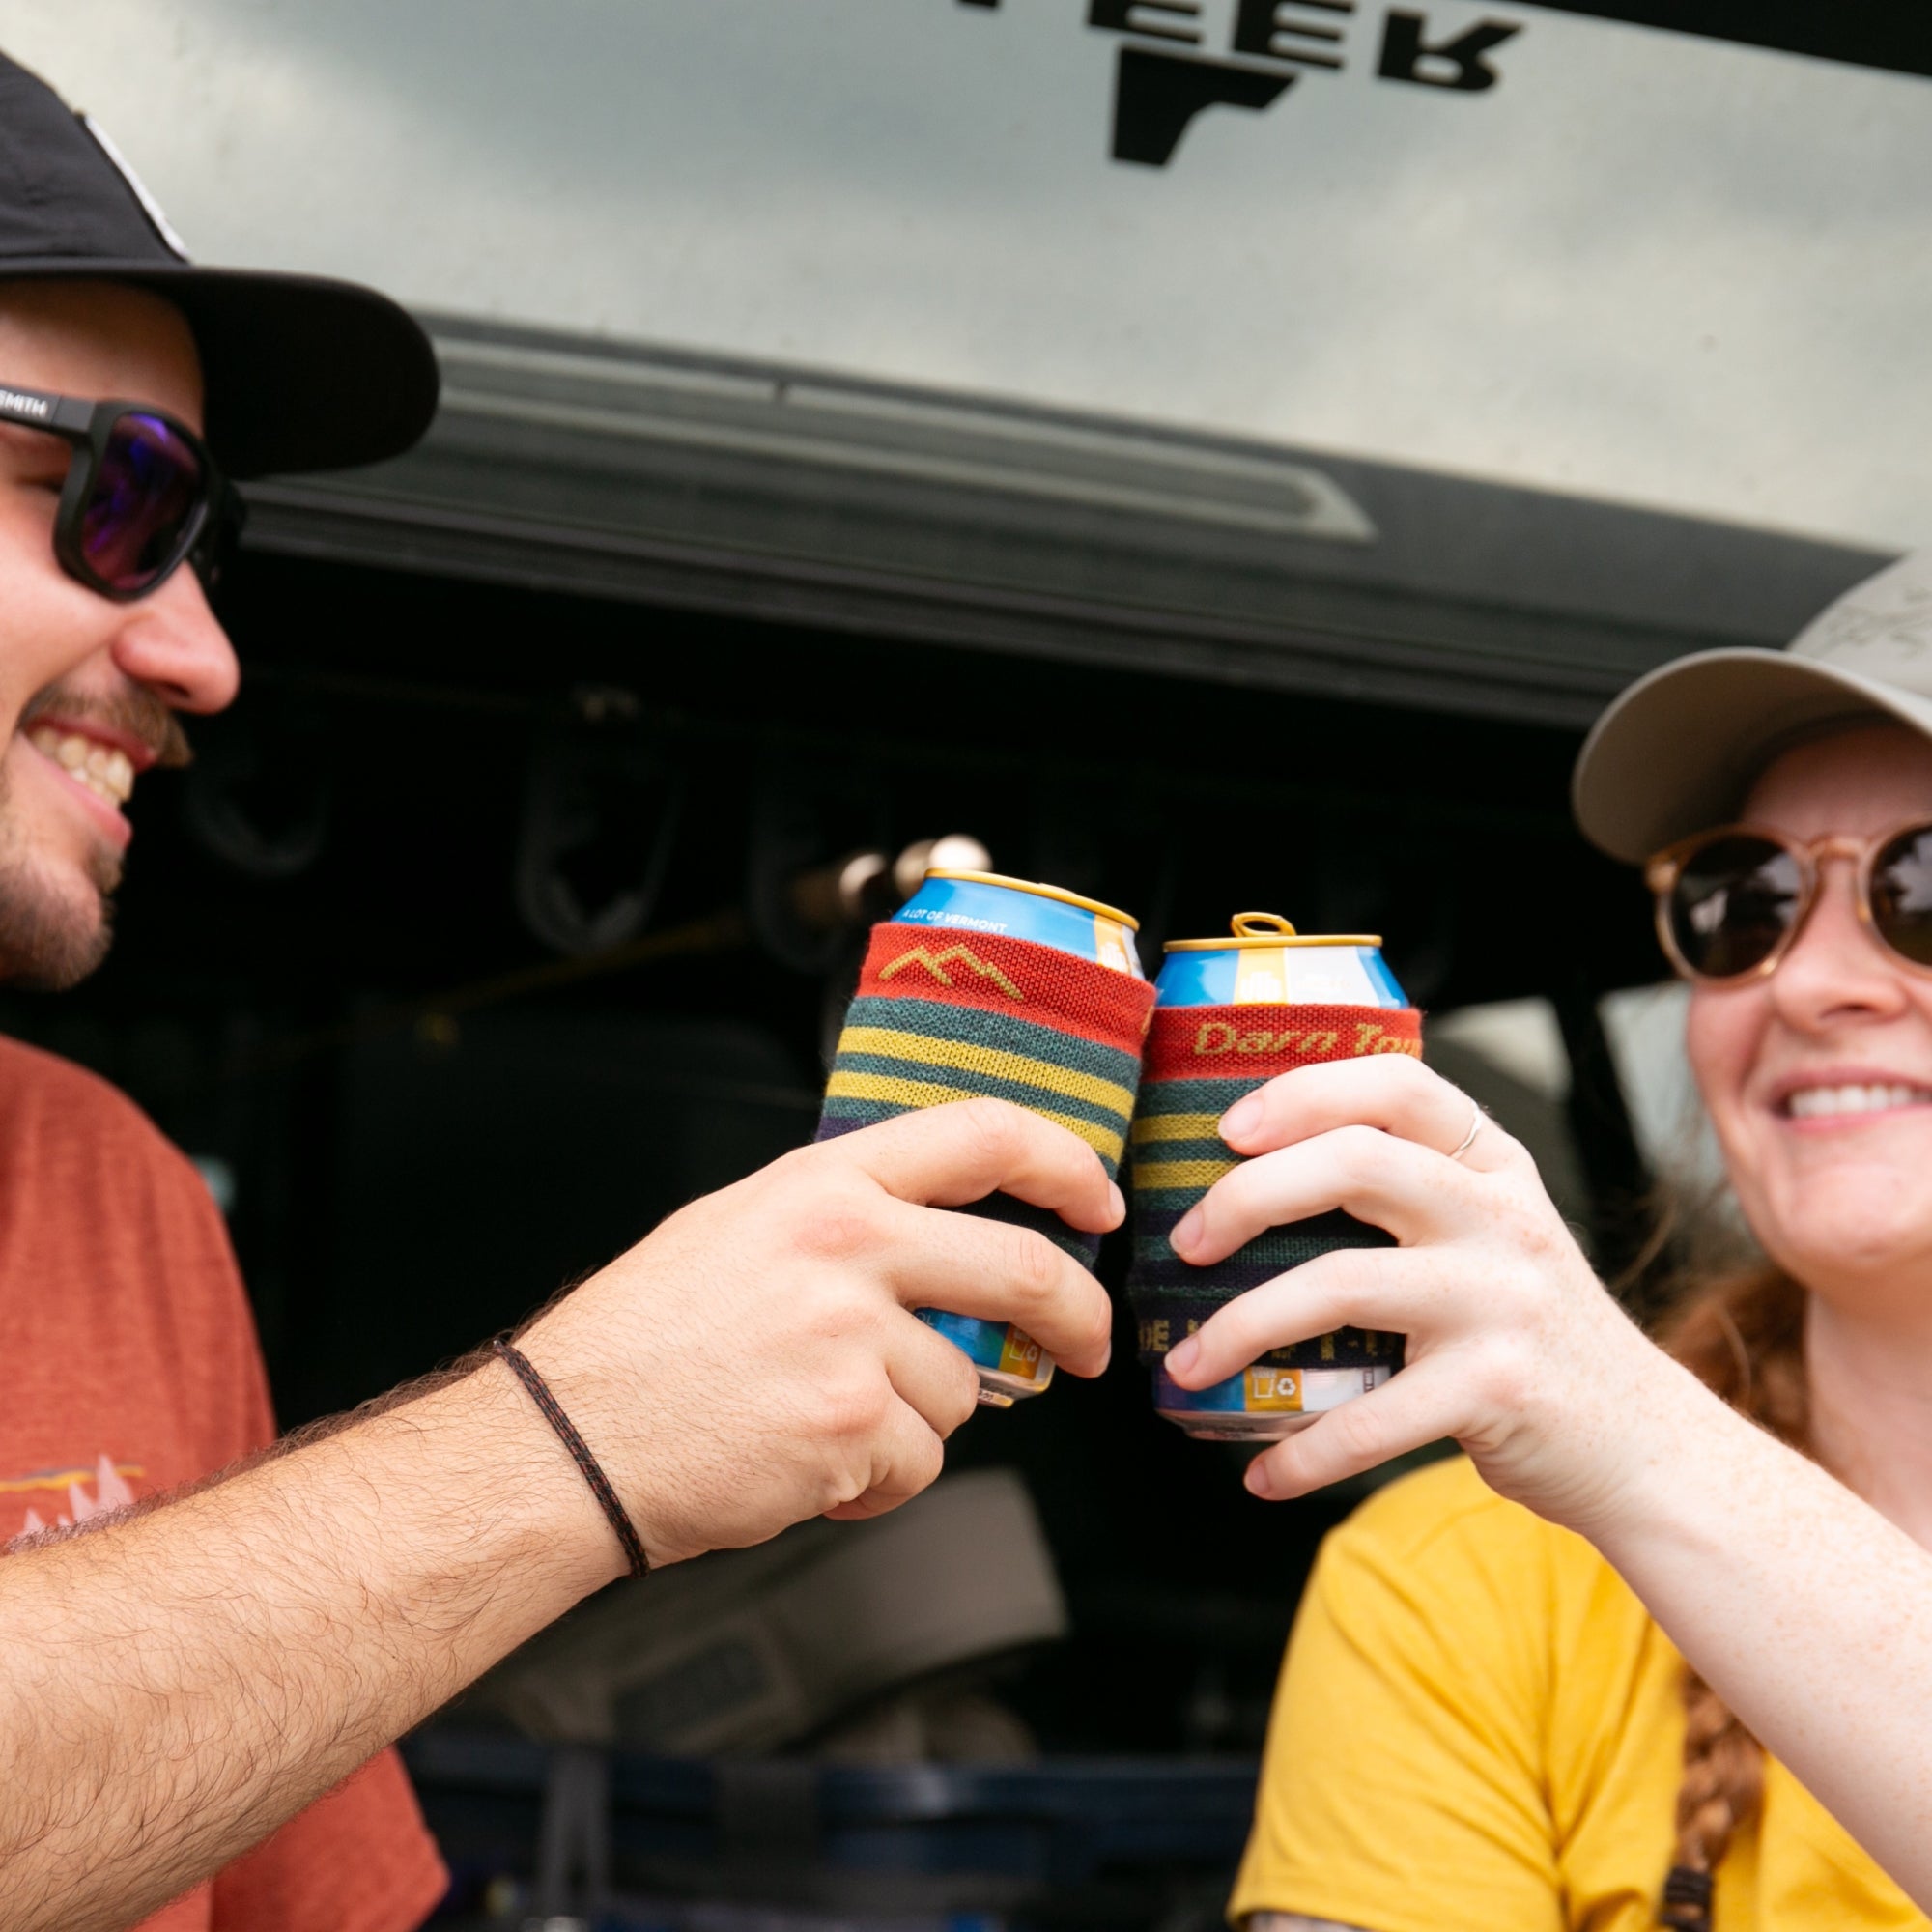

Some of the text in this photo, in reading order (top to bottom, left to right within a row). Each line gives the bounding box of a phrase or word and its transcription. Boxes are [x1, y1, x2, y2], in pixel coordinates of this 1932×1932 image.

[0, 389, 48, 416] SMITH
[910, 908, 927, 919] LOT
[926, 910, 944, 921] OF
[944, 913, 1009, 933] VERMONT
[1193, 1022, 1339, 1056] Darn
